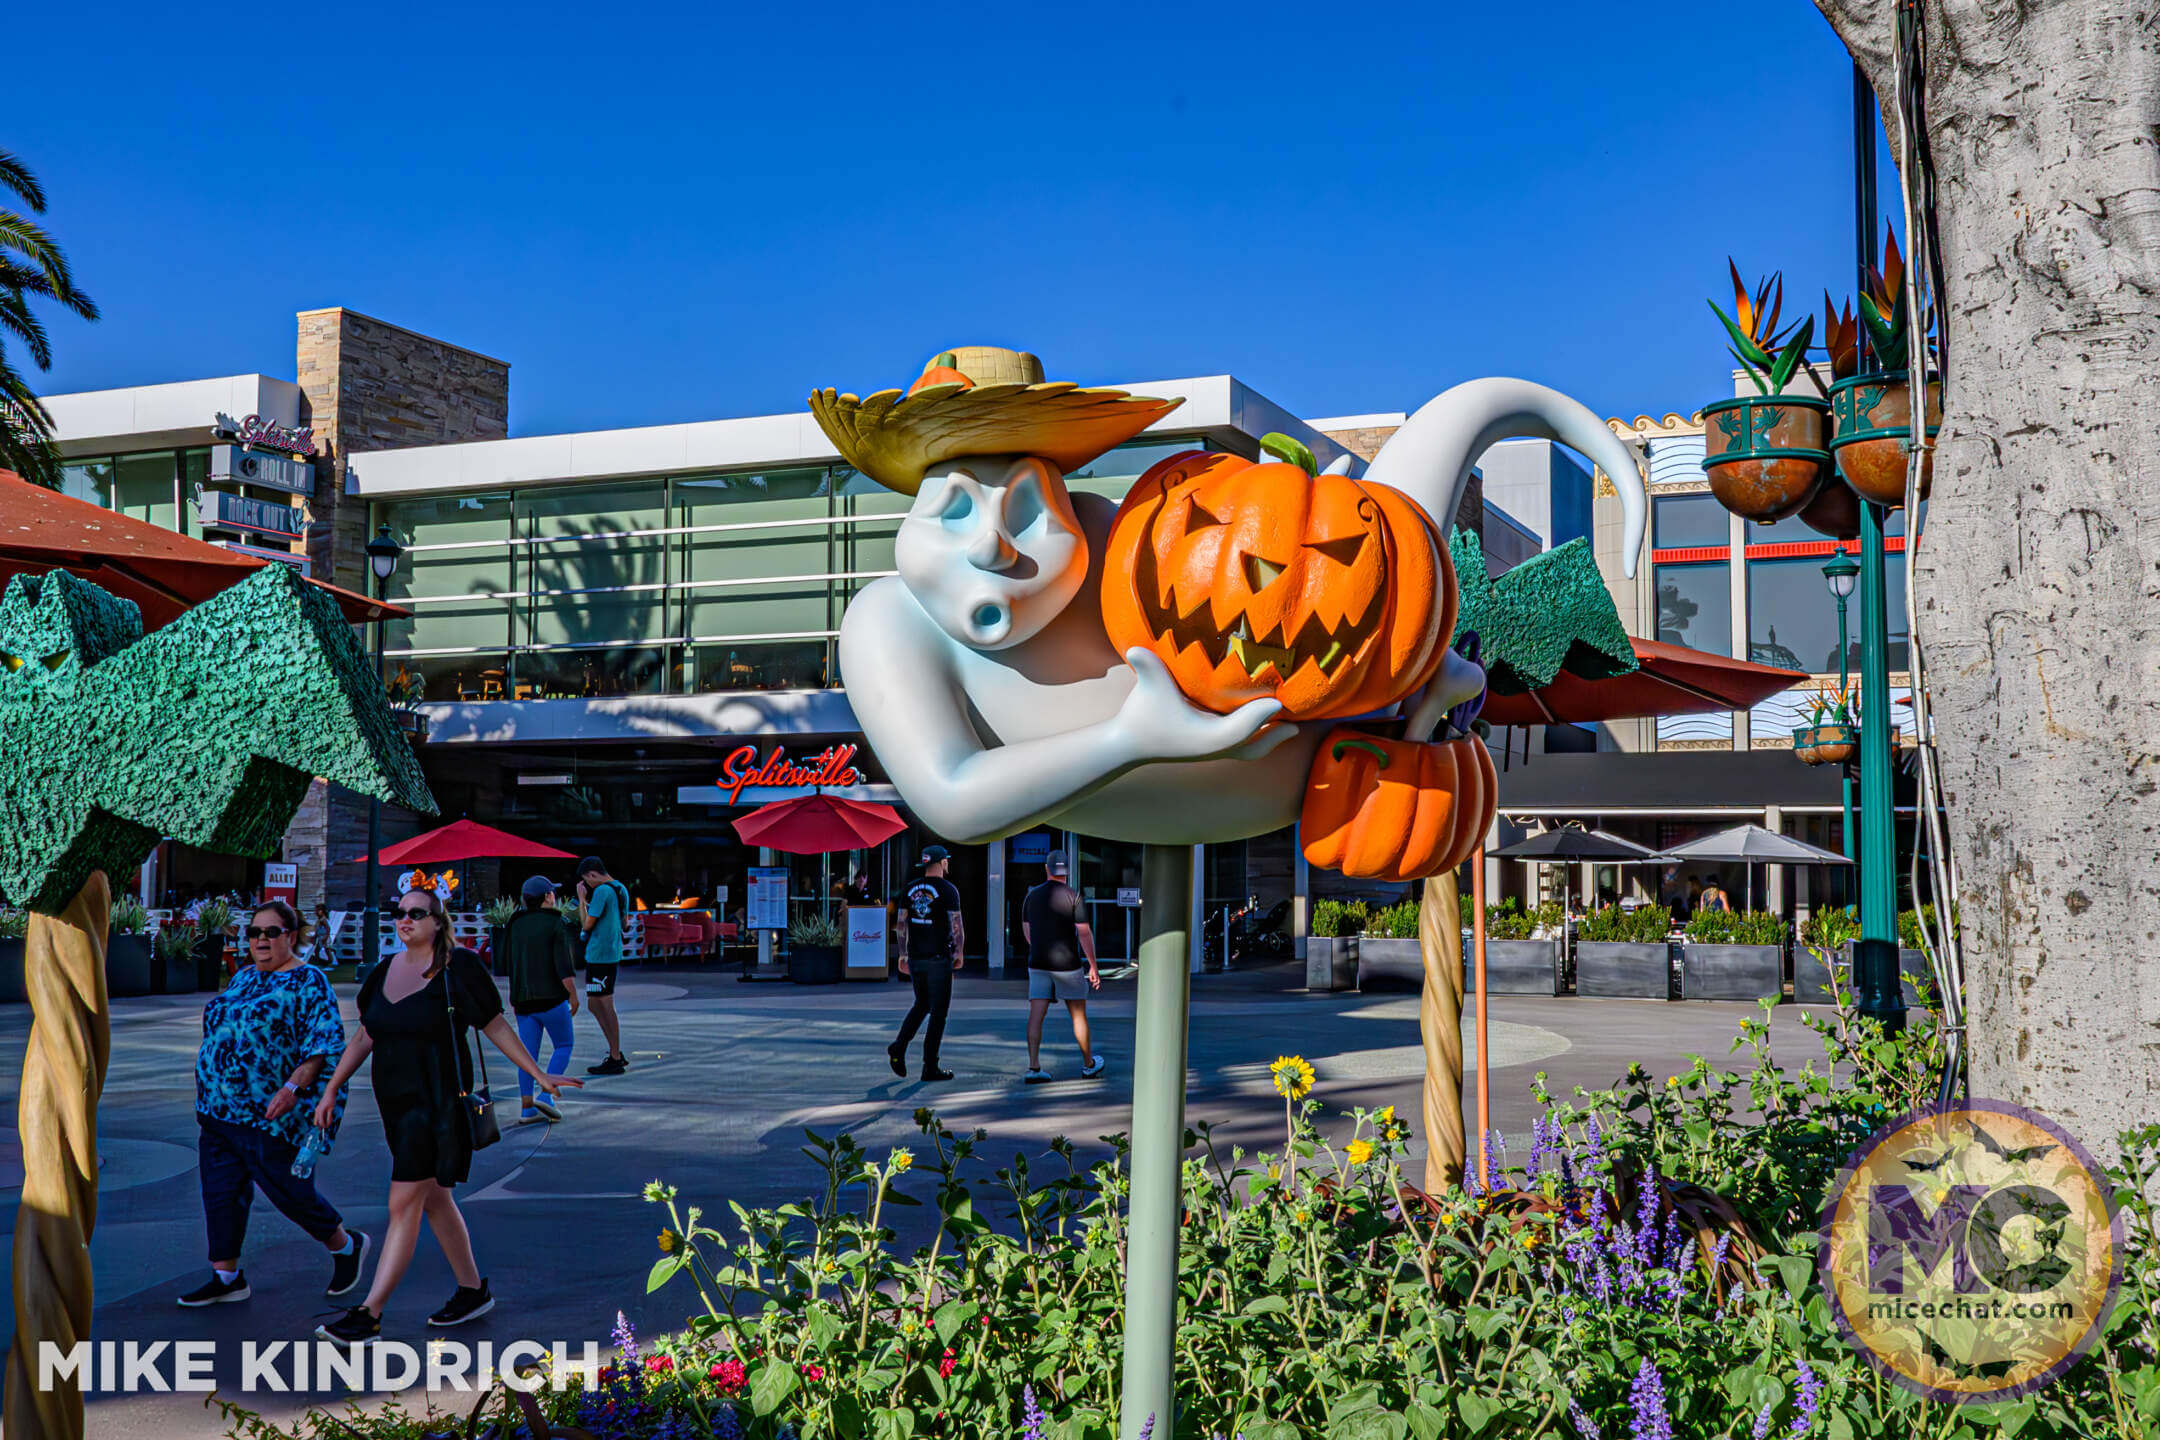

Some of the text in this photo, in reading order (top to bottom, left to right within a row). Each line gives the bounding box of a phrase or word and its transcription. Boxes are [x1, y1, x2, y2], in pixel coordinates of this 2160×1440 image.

[240, 415, 317, 455] Splitsville
[260, 456, 306, 489] ROLL IN
[228, 497, 286, 531] ROCK OUT
[716, 743, 858, 805] Splitsville
